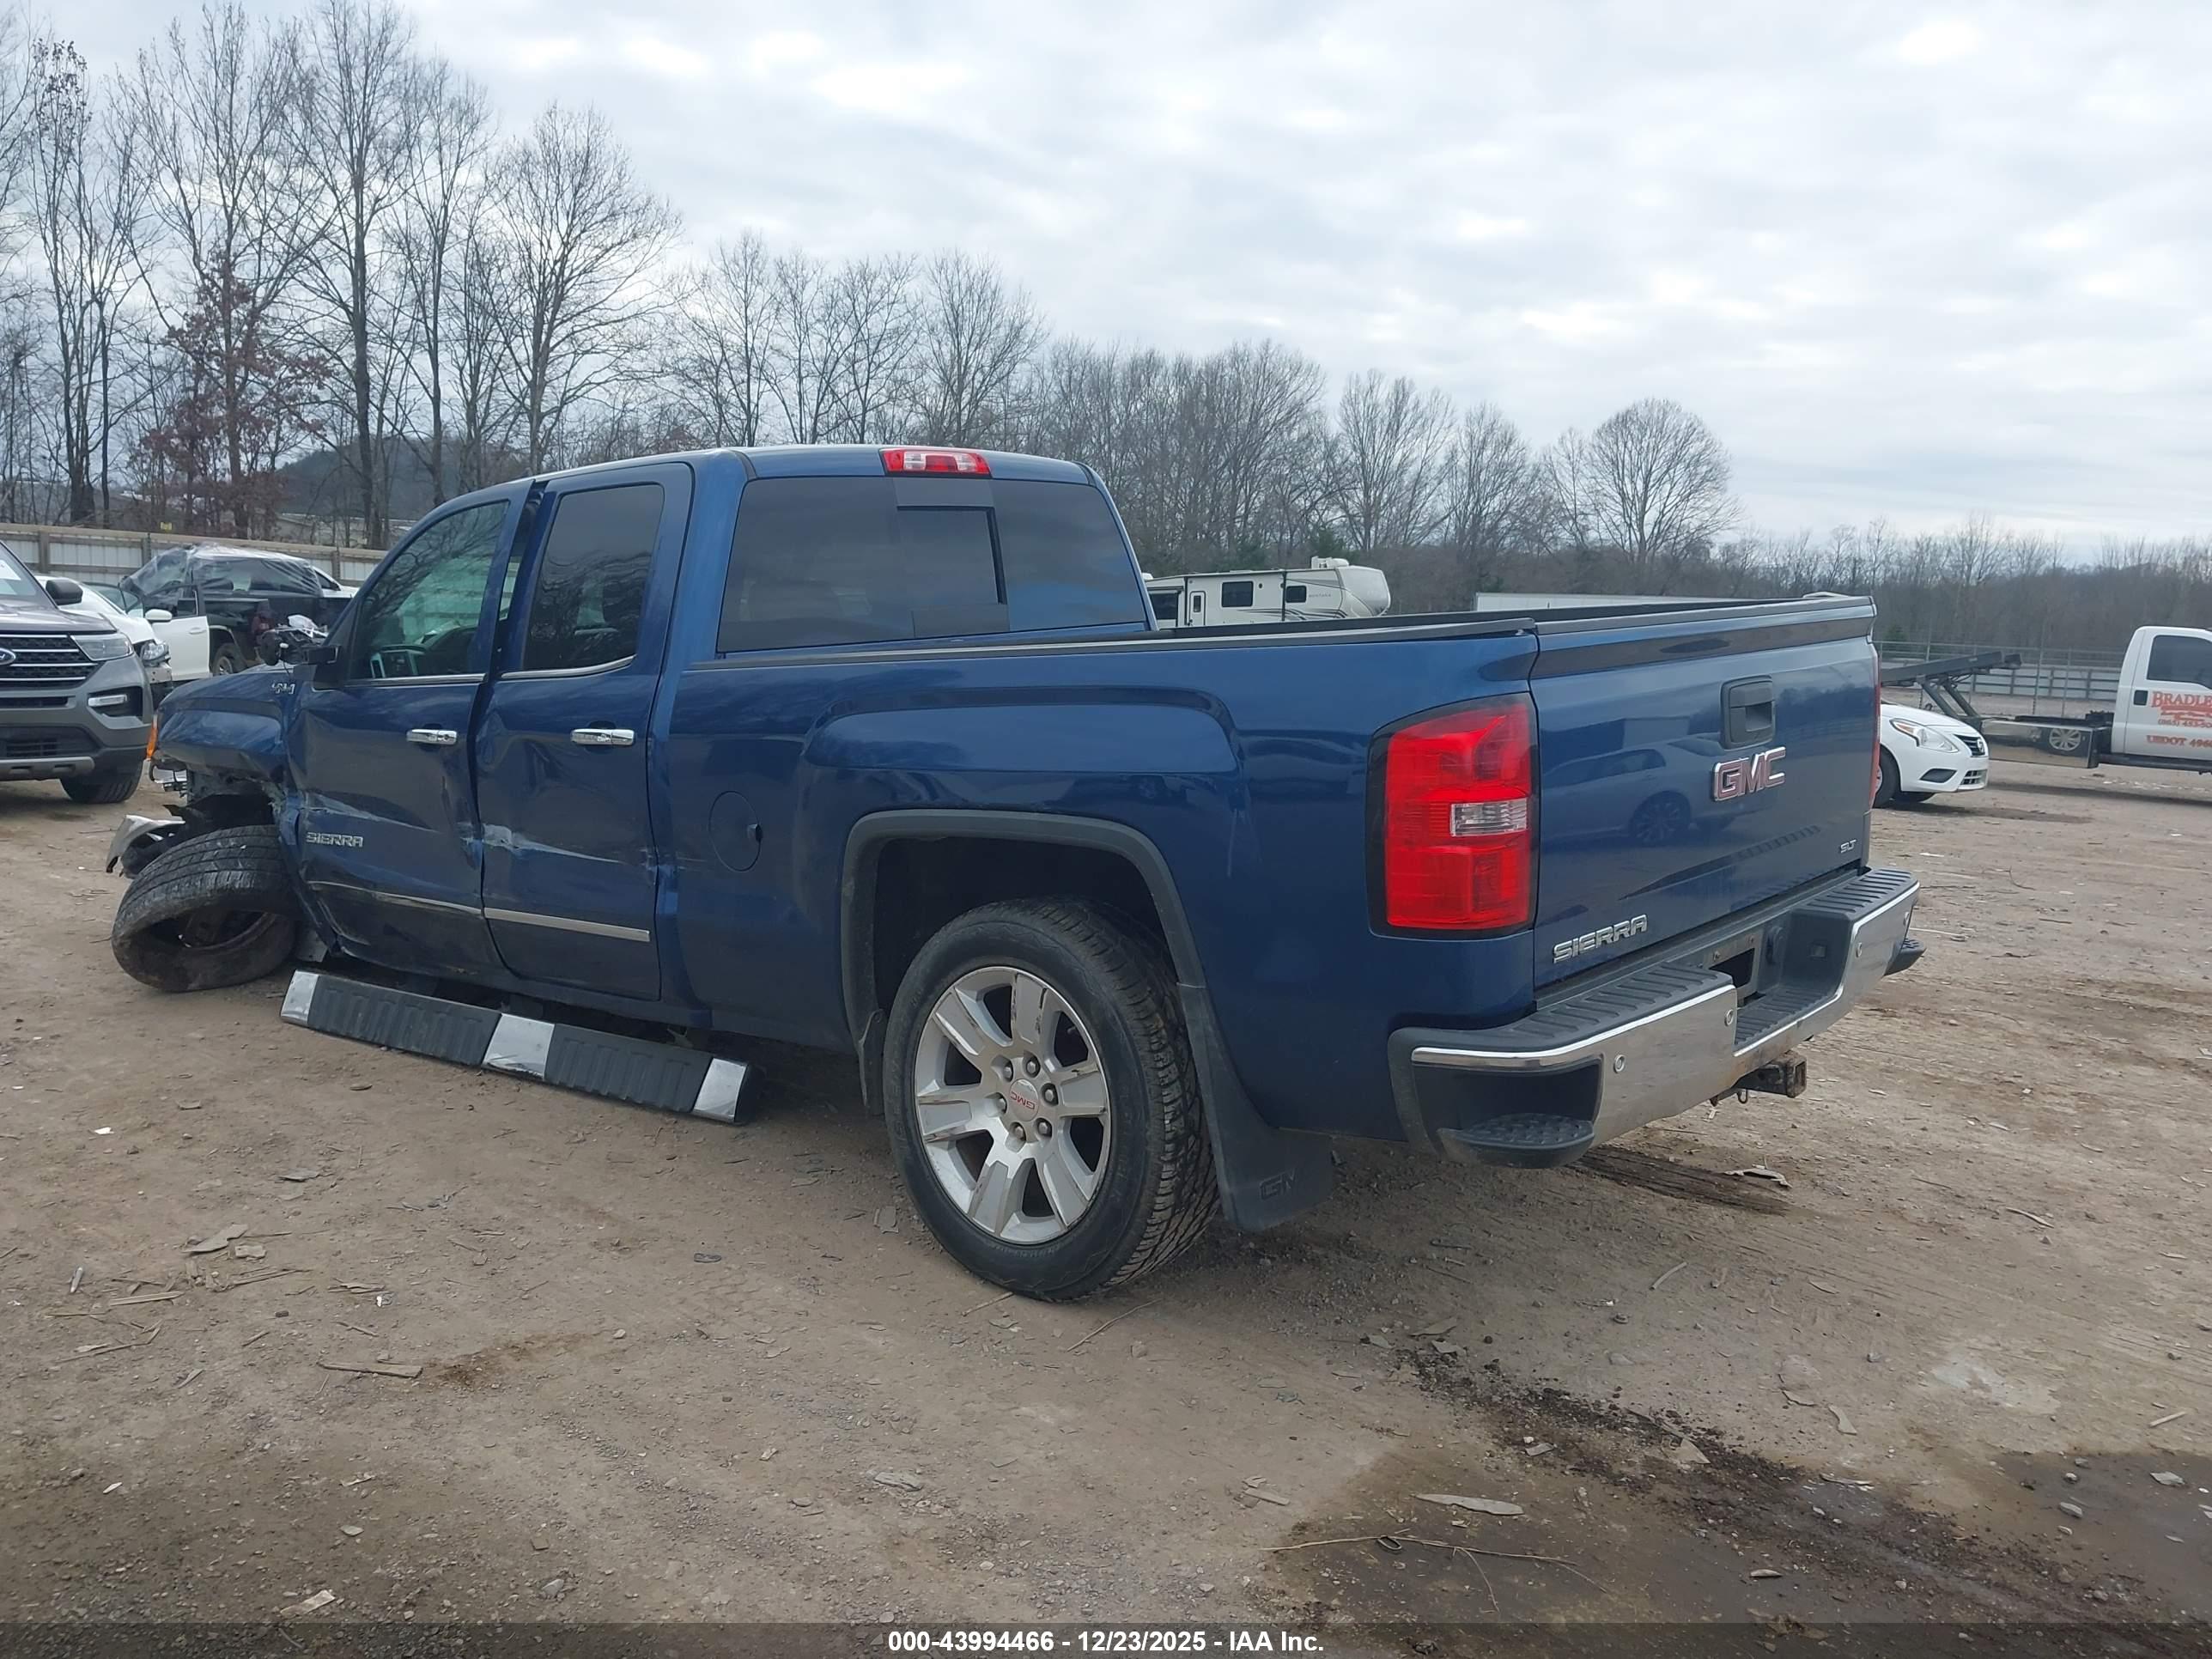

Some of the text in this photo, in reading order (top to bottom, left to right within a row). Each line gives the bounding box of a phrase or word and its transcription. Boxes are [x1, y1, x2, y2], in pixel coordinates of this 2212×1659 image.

[1714, 746, 1786, 801] GMC
[305, 831, 364, 848] SIERRA
[1839, 838, 1856, 854] SLT
[1553, 914, 1648, 963] SIERRA
[1010, 1091, 1036, 1110] GMC
